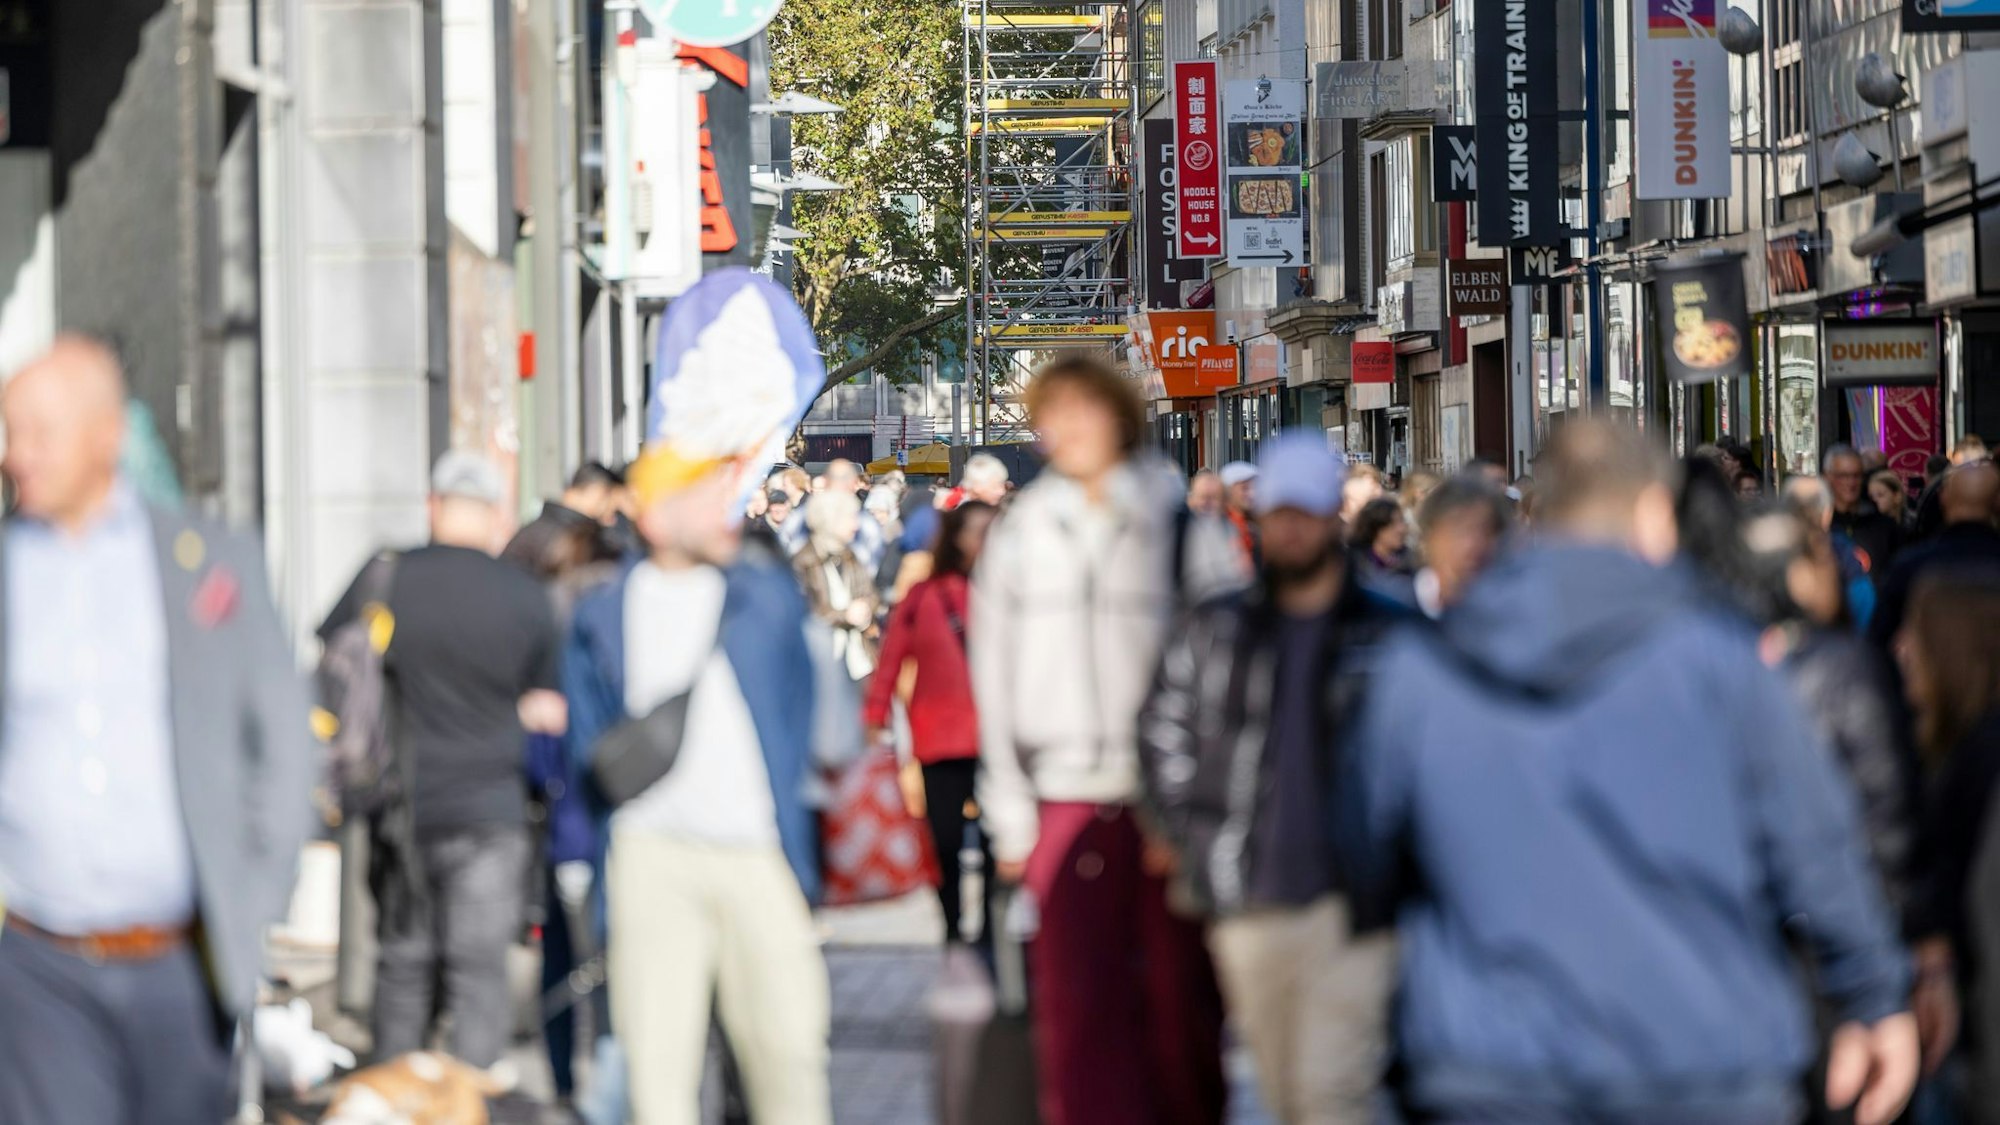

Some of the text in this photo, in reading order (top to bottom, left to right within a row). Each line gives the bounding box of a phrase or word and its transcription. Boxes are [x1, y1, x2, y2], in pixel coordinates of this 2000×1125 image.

[1334, 74, 1400, 87] Juwelier
[1320, 91, 1400, 106] Fine ART
[1506, 0, 1529, 191] KING OF TRAIN
[1184, 187, 1216, 197] NOODLE
[1188, 200, 1215, 210] HOUSE
[1159, 143, 1177, 283] FOSSIL
[1452, 271, 1501, 285] ELBEN
[1455, 289, 1501, 303] WALD
